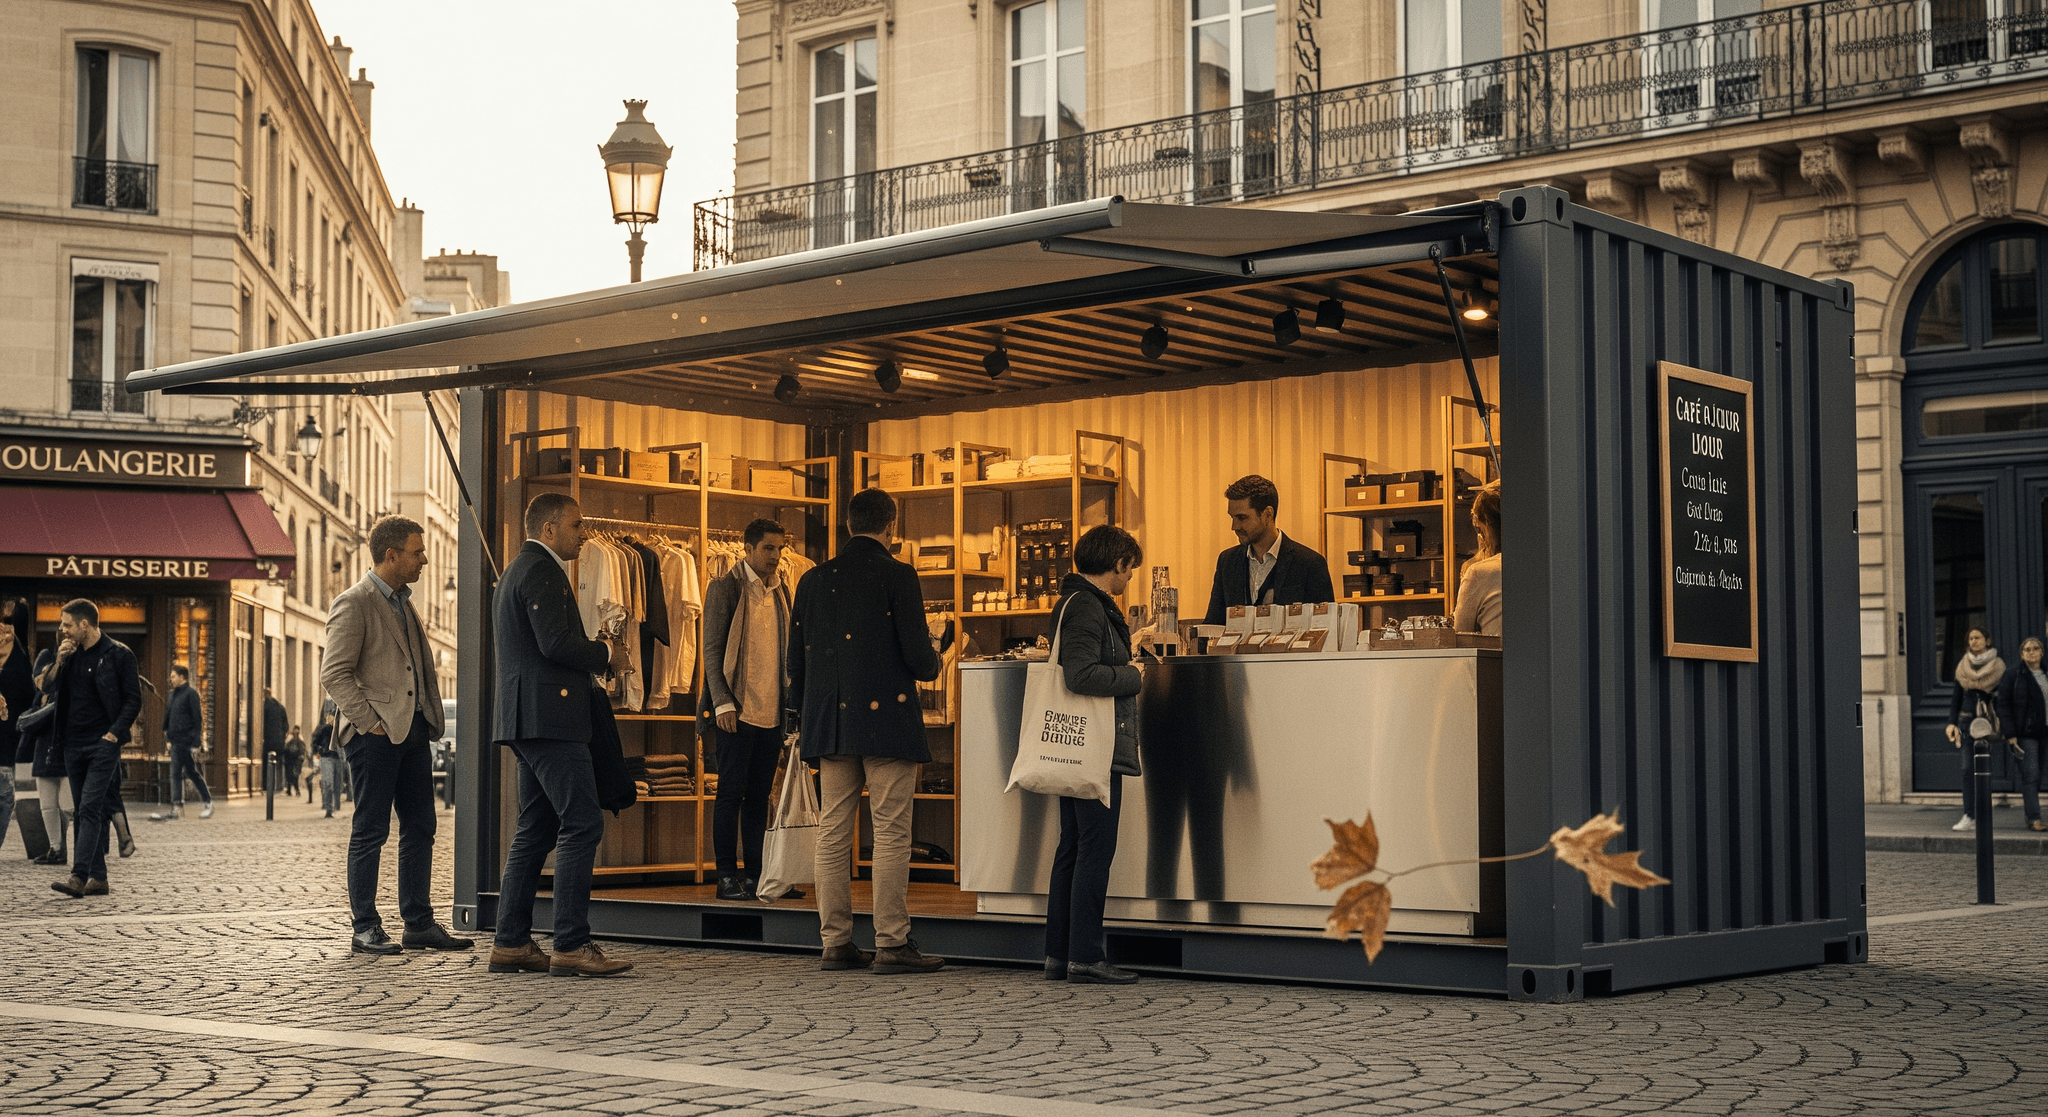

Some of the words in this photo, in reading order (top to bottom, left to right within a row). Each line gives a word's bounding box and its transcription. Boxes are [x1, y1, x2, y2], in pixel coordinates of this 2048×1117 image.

[1676, 396, 1701, 424] CAFÉ
[0, 444, 217, 479] OULANGERIE
[46, 555, 210, 579] PÂTISSERIE
